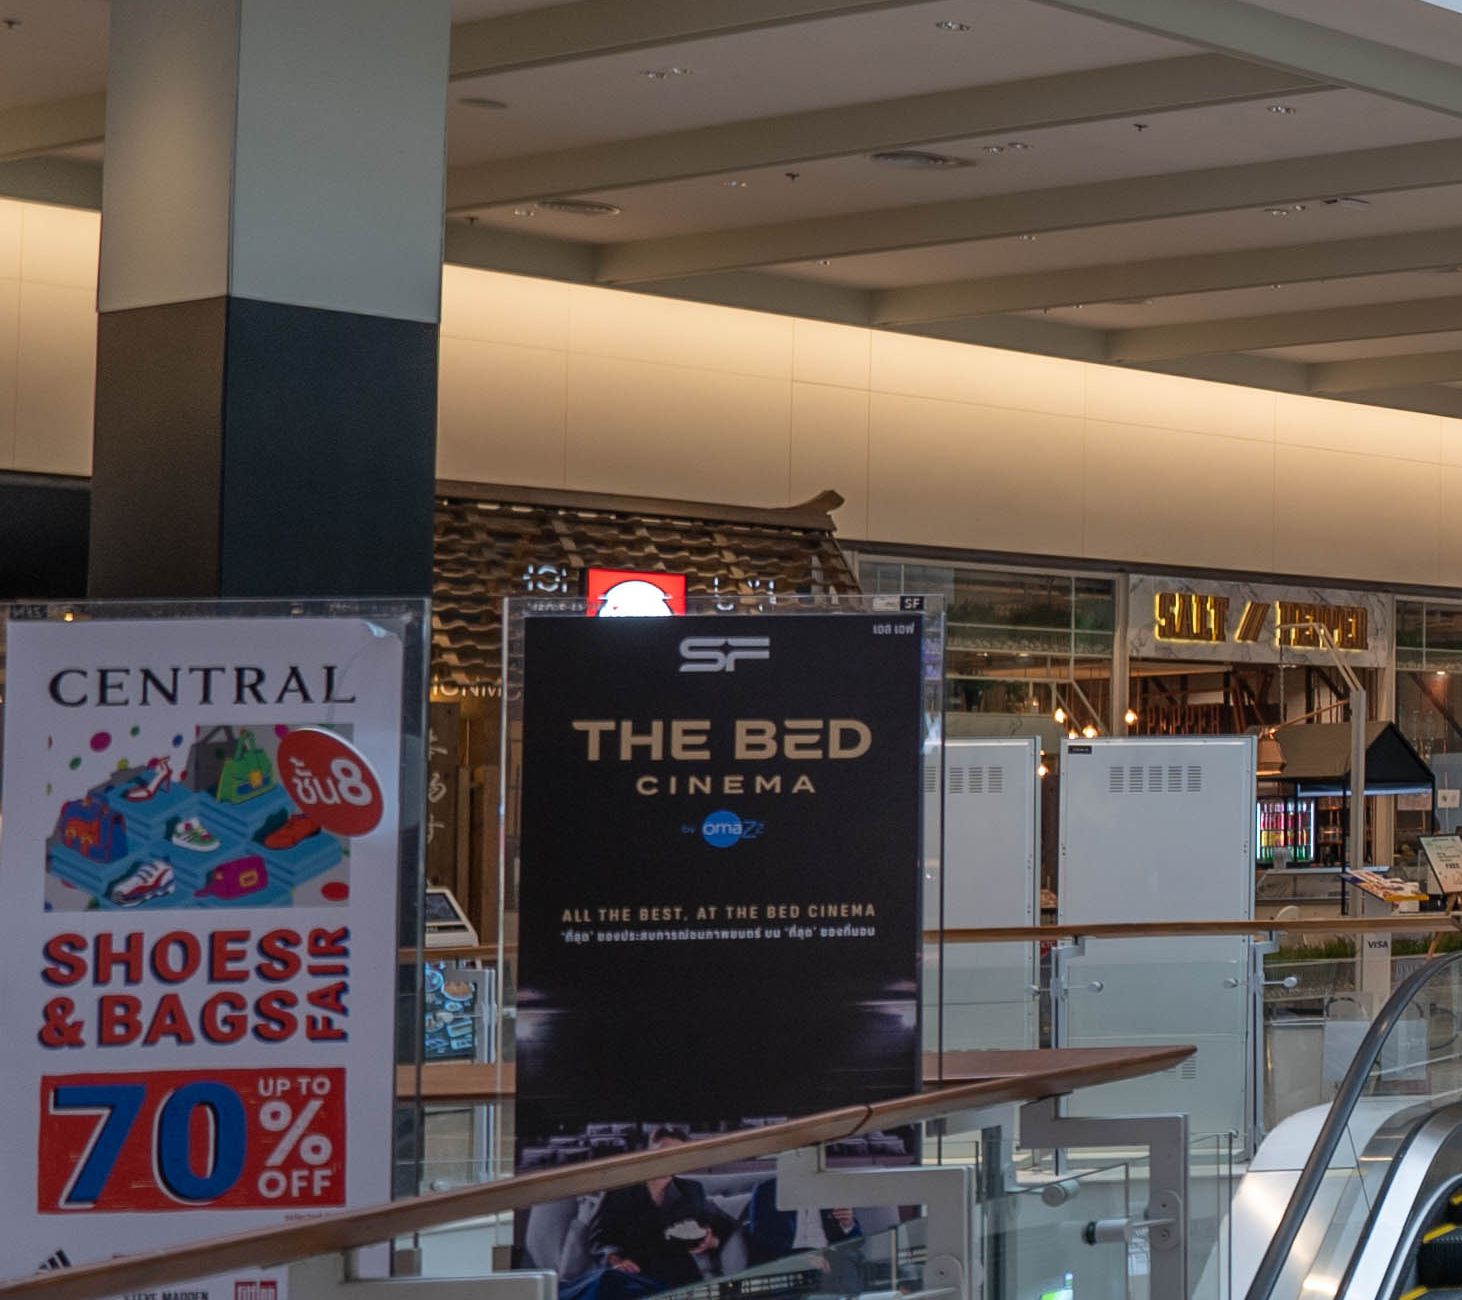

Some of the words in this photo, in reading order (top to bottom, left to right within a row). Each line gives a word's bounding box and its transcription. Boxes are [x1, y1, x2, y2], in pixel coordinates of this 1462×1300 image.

[1155, 592, 1230, 643] SALT
[679, 636, 771, 672] SF
[48, 666, 356, 708] CENTRAL
[572, 718, 712, 761] THE
[735, 718, 872, 760] BED
[289, 755, 373, 806] ชั้น8
[635, 775, 816, 796] CINEMA
[562, 908, 592, 923] ALL
[600, 908, 631, 922] THE
[697, 907, 718, 921] AT
[727, 906, 758, 920] THE
[767, 906, 800, 919] BED
[808, 904, 876, 918] CINEMA
[41, 928, 302, 986] SHOES
[1368, 940, 1389, 949] VISA
[305, 926, 350, 1042] FAIR
[38, 996, 86, 1048] &
[97, 990, 299, 1047] BAGS
[258, 1078, 290, 1097] UP
[297, 1077, 331, 1096] TO
[49, 1080, 248, 1210] 70
[257, 1170, 332, 1199] OFF
